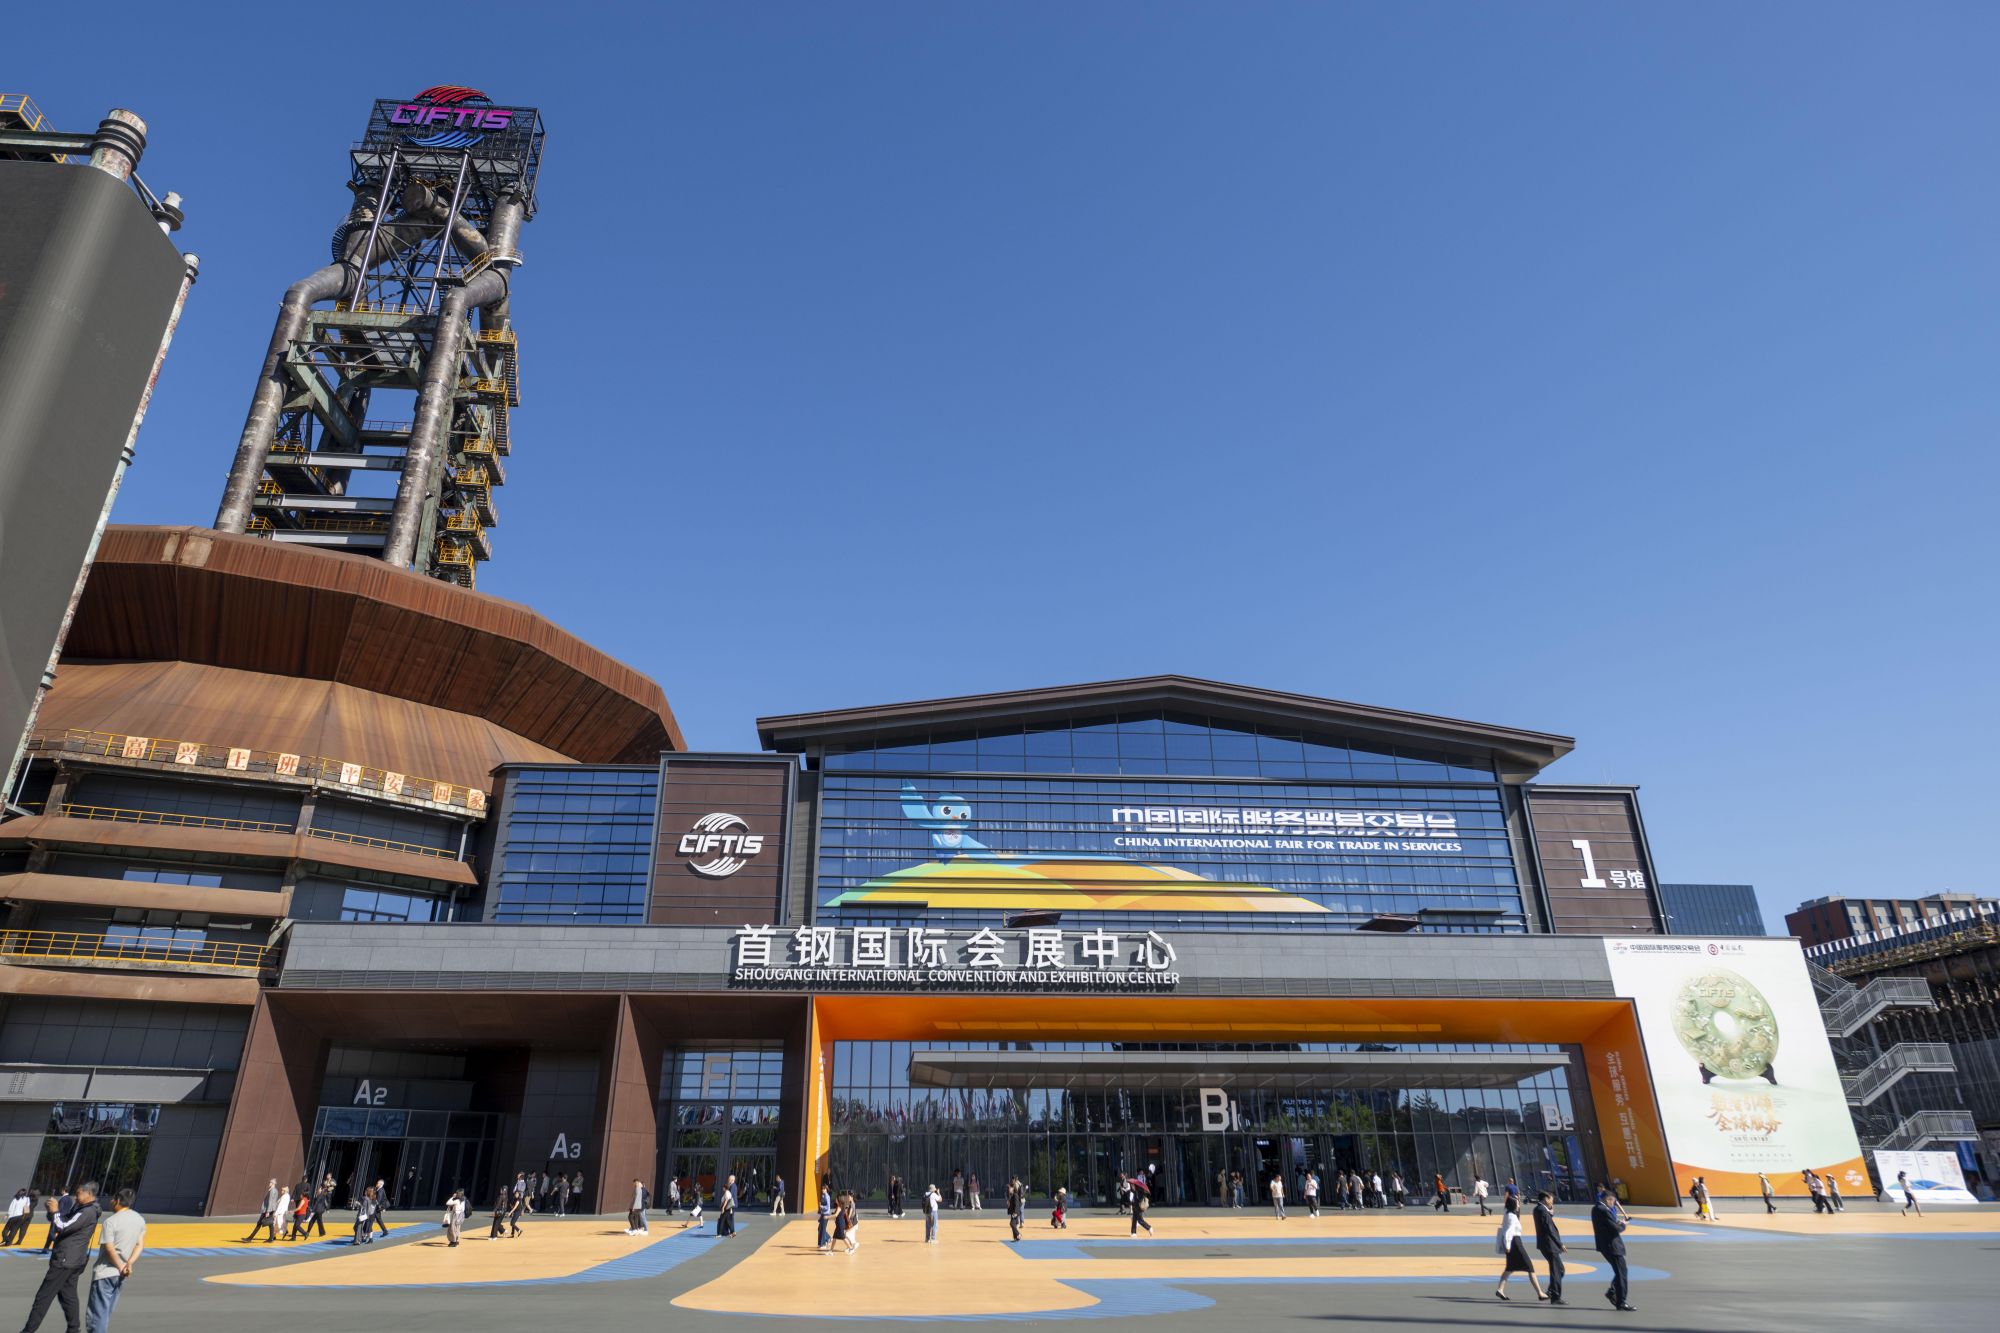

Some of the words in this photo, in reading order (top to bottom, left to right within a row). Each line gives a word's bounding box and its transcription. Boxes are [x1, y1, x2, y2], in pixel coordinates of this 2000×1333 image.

[390, 104, 513, 129] CIFTIS
[678, 834, 764, 854] CIFTIS
[1114, 837, 1161, 847] CHINA
[1163, 838, 1272, 849] INTERNATIONAL
[1275, 839, 1303, 849] FAIR
[1307, 840, 1335, 850] FOR
[1338, 840, 1382, 851] TRADE
[1384, 841, 1400, 851] IN
[1403, 841, 1462, 852] SERVICES
[735, 923, 1177, 969] 首钢国际会展中心
[735, 967, 817, 981] SHOUGANG
[816, 968, 923, 982] INTERNATIONAL
[928, 969, 1018, 983] CONVENTION
[1019, 971, 1047, 983] AND
[1050, 971, 1128, 984] EXHIBITION
[1128, 972, 1180, 984] CENTER
[353, 1079, 388, 1105] A2
[1282, 1098, 1326, 1106] AUSTRAIA
[1541, 1104, 1575, 1131] B2
[550, 1133, 582, 1159] A3
